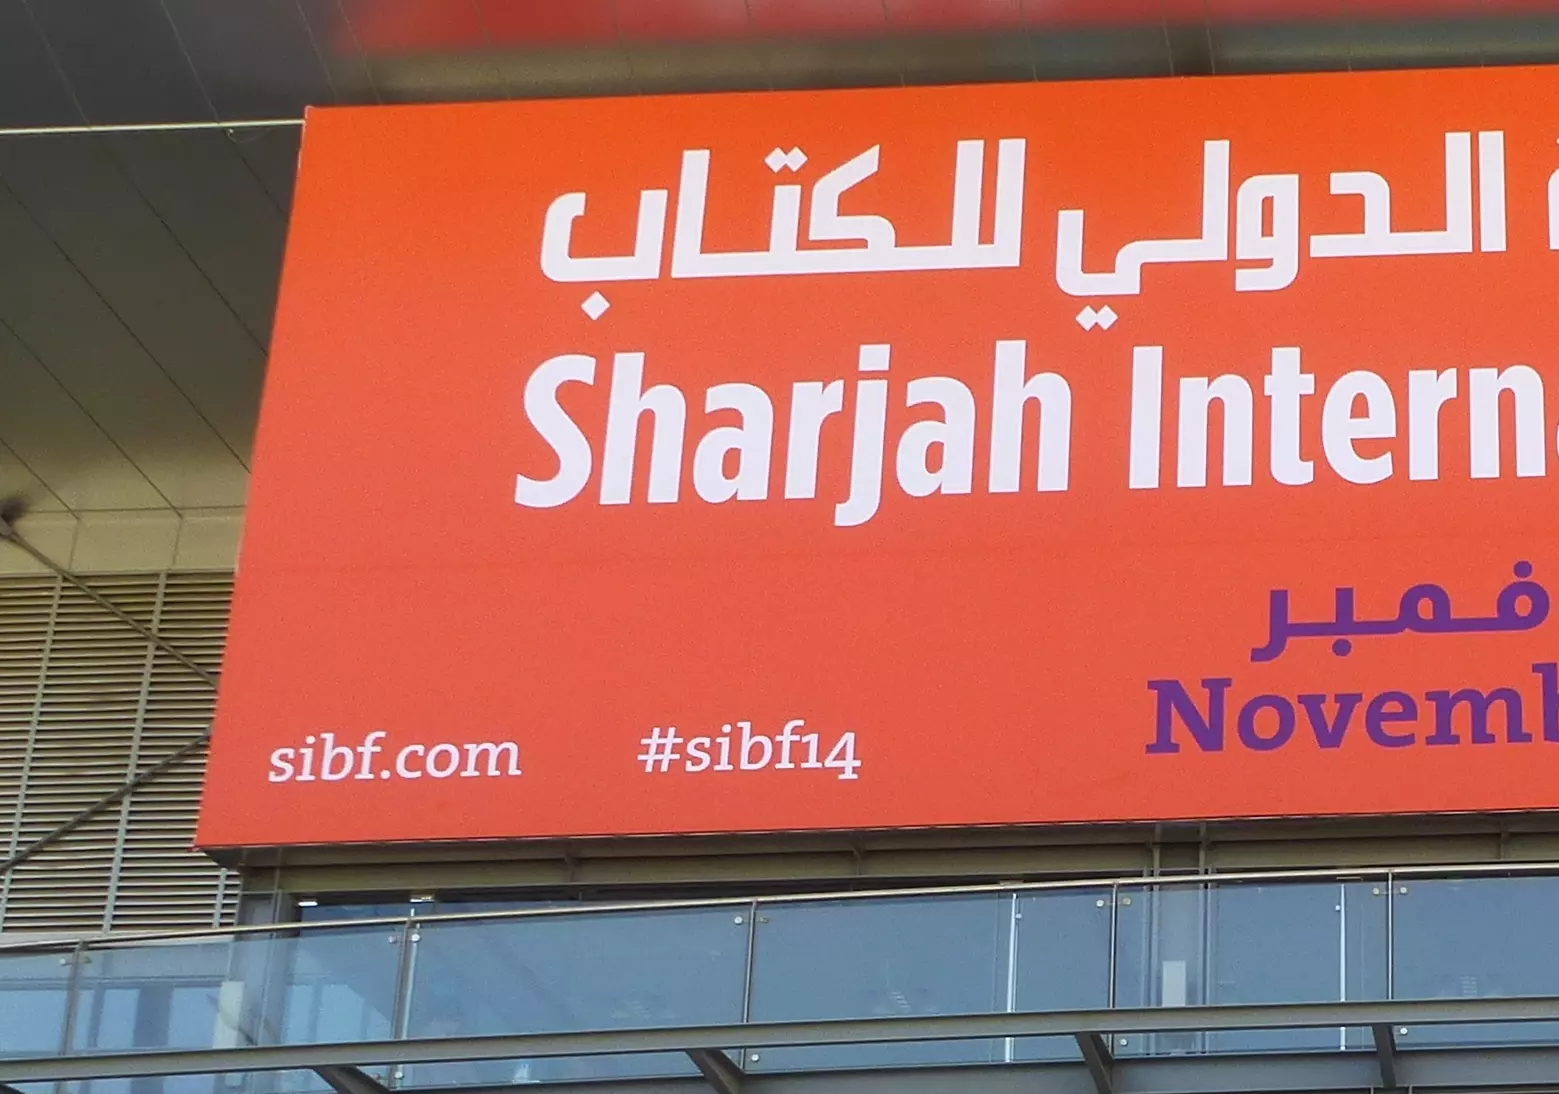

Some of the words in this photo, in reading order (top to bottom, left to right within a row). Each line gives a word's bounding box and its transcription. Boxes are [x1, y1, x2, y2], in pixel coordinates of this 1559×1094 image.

[538, 138, 1026, 321] للكتاب
[1055, 130, 1507, 331] الدولي
[514, 339, 1072, 527] Sharjah
[268, 730, 522, 783] sibf.com
[637, 719, 862, 780] #sibf14
